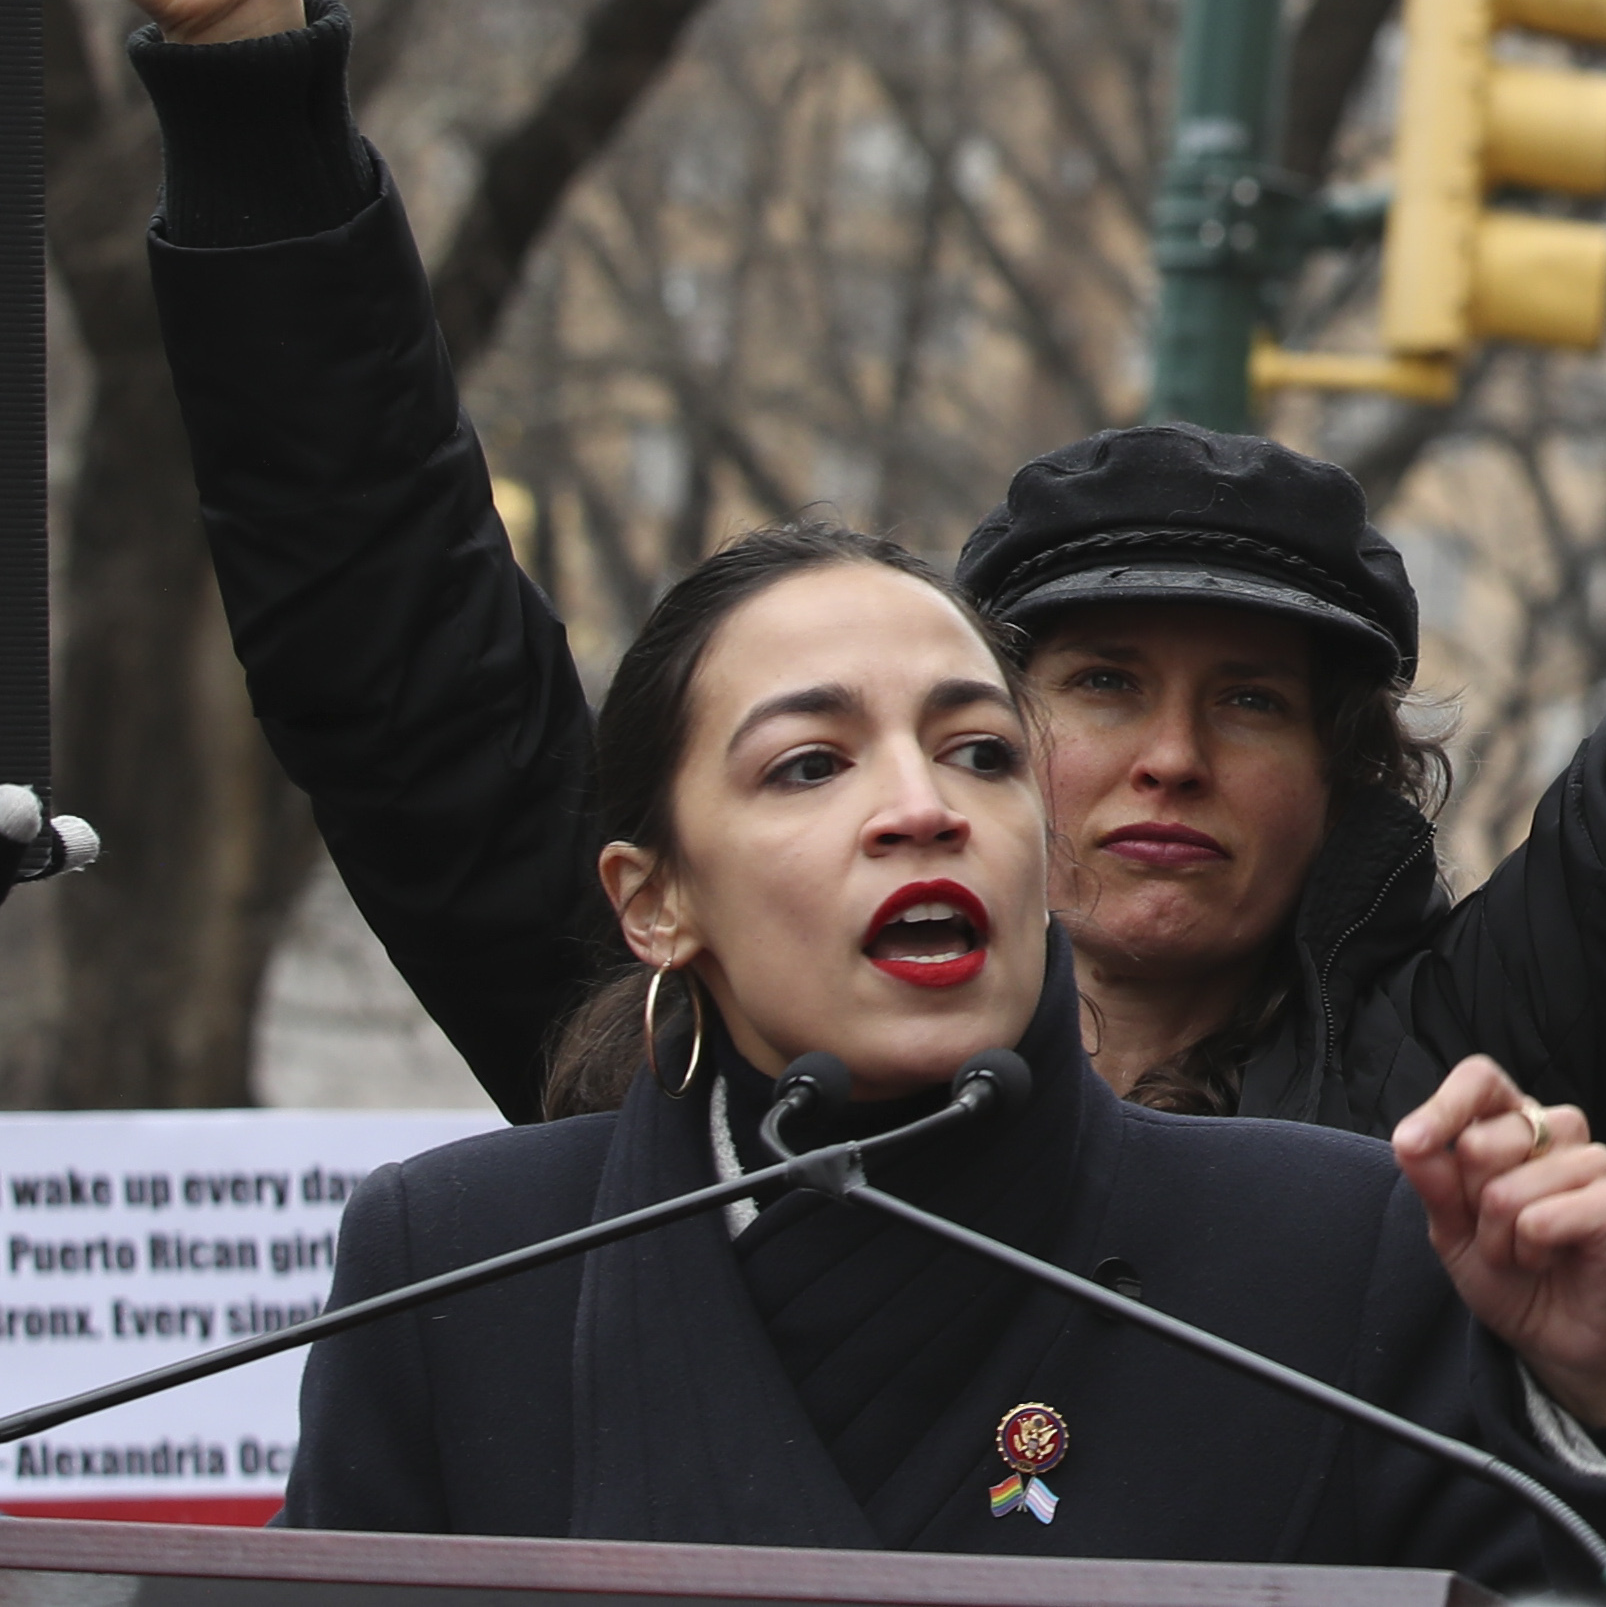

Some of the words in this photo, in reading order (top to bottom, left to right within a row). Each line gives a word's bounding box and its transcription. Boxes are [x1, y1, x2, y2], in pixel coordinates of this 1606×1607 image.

[10, 1166, 112, 1208] wake
[123, 1174, 171, 1208] up
[183, 1174, 290, 1208] every
[8, 1235, 137, 1273] Puerto
[149, 1234, 259, 1271] Rican
[0, 1303, 100, 1340] ronx.
[110, 1298, 215, 1339] Every
[16, 1441, 226, 1477] Alexandria
